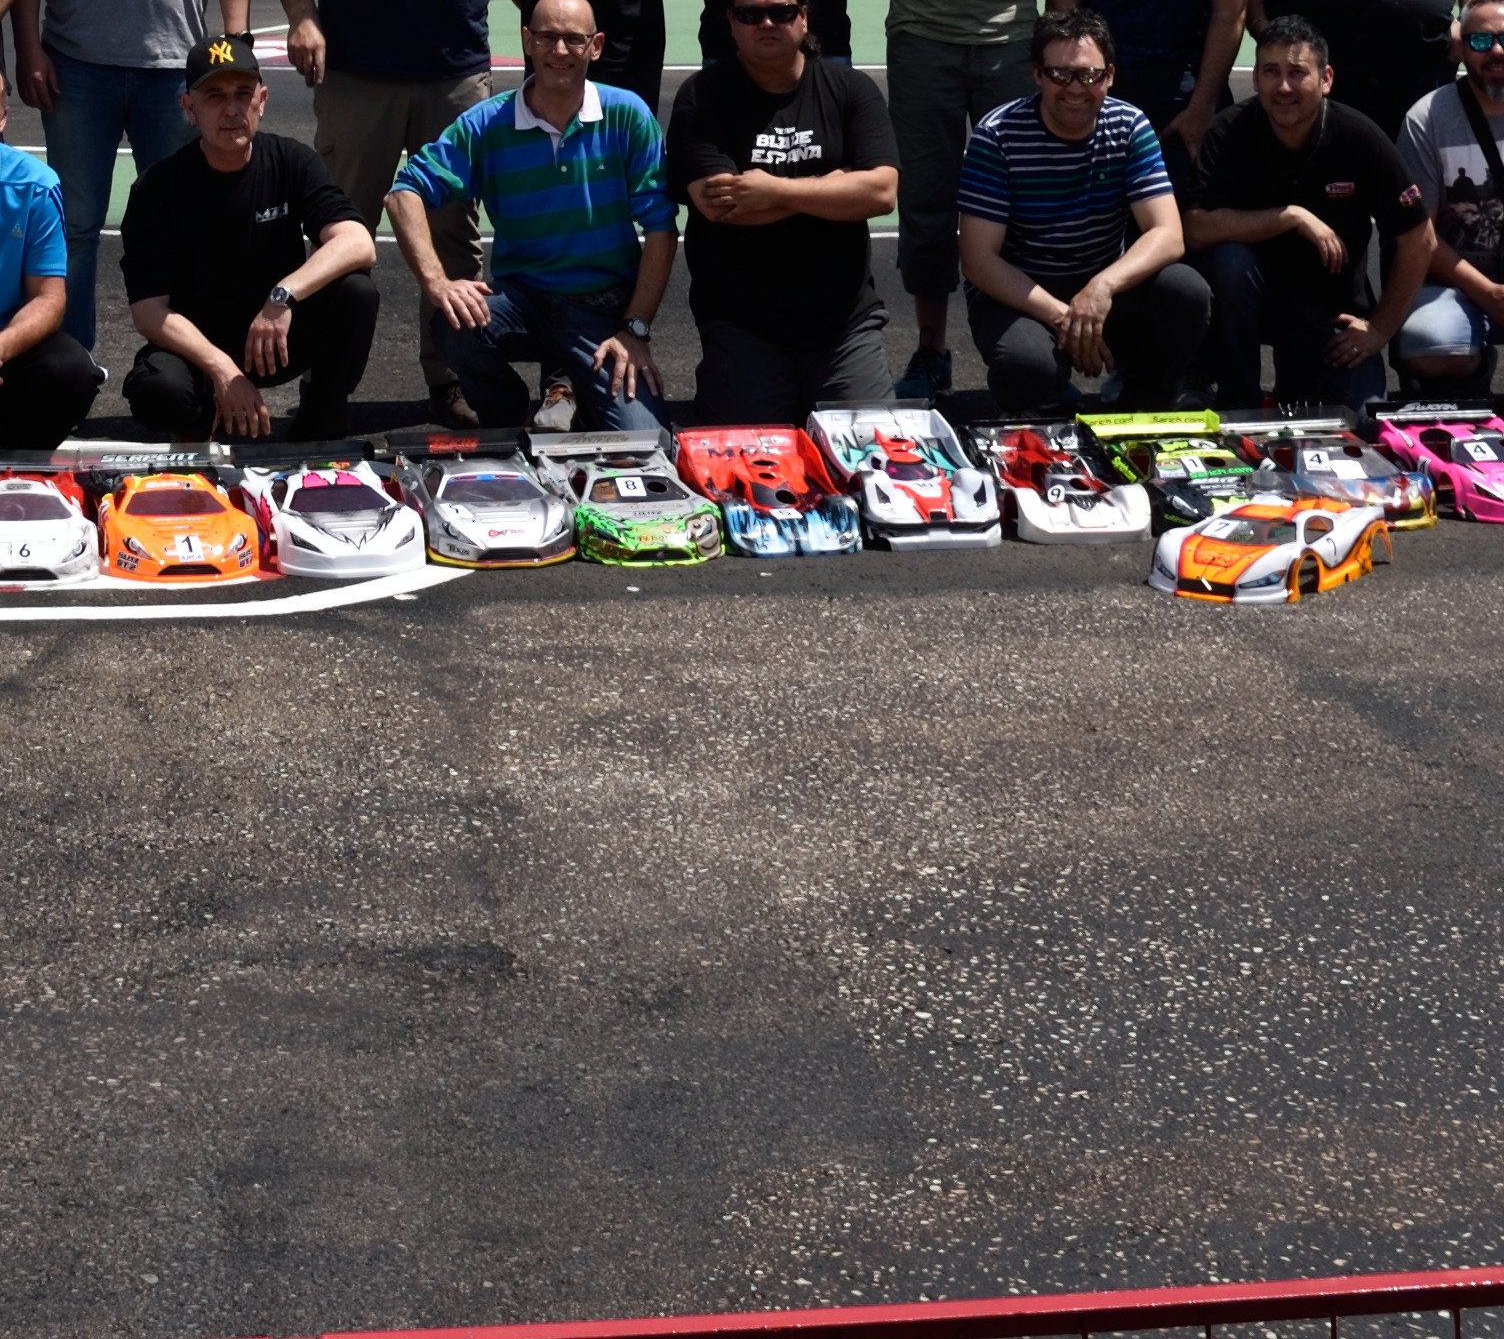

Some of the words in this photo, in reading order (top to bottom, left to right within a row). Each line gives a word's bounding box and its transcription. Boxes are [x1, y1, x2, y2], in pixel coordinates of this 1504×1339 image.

[208, 40, 234, 64] NY
[1473, 444, 1488, 455] 4
[101, 453, 199, 463] SERPENT
[1310, 453, 1323, 465] 4
[625, 479, 637, 491] 8
[1051, 488, 1062, 501] 9
[19, 543, 31, 558] 6
[182, 536, 193, 553] 1
